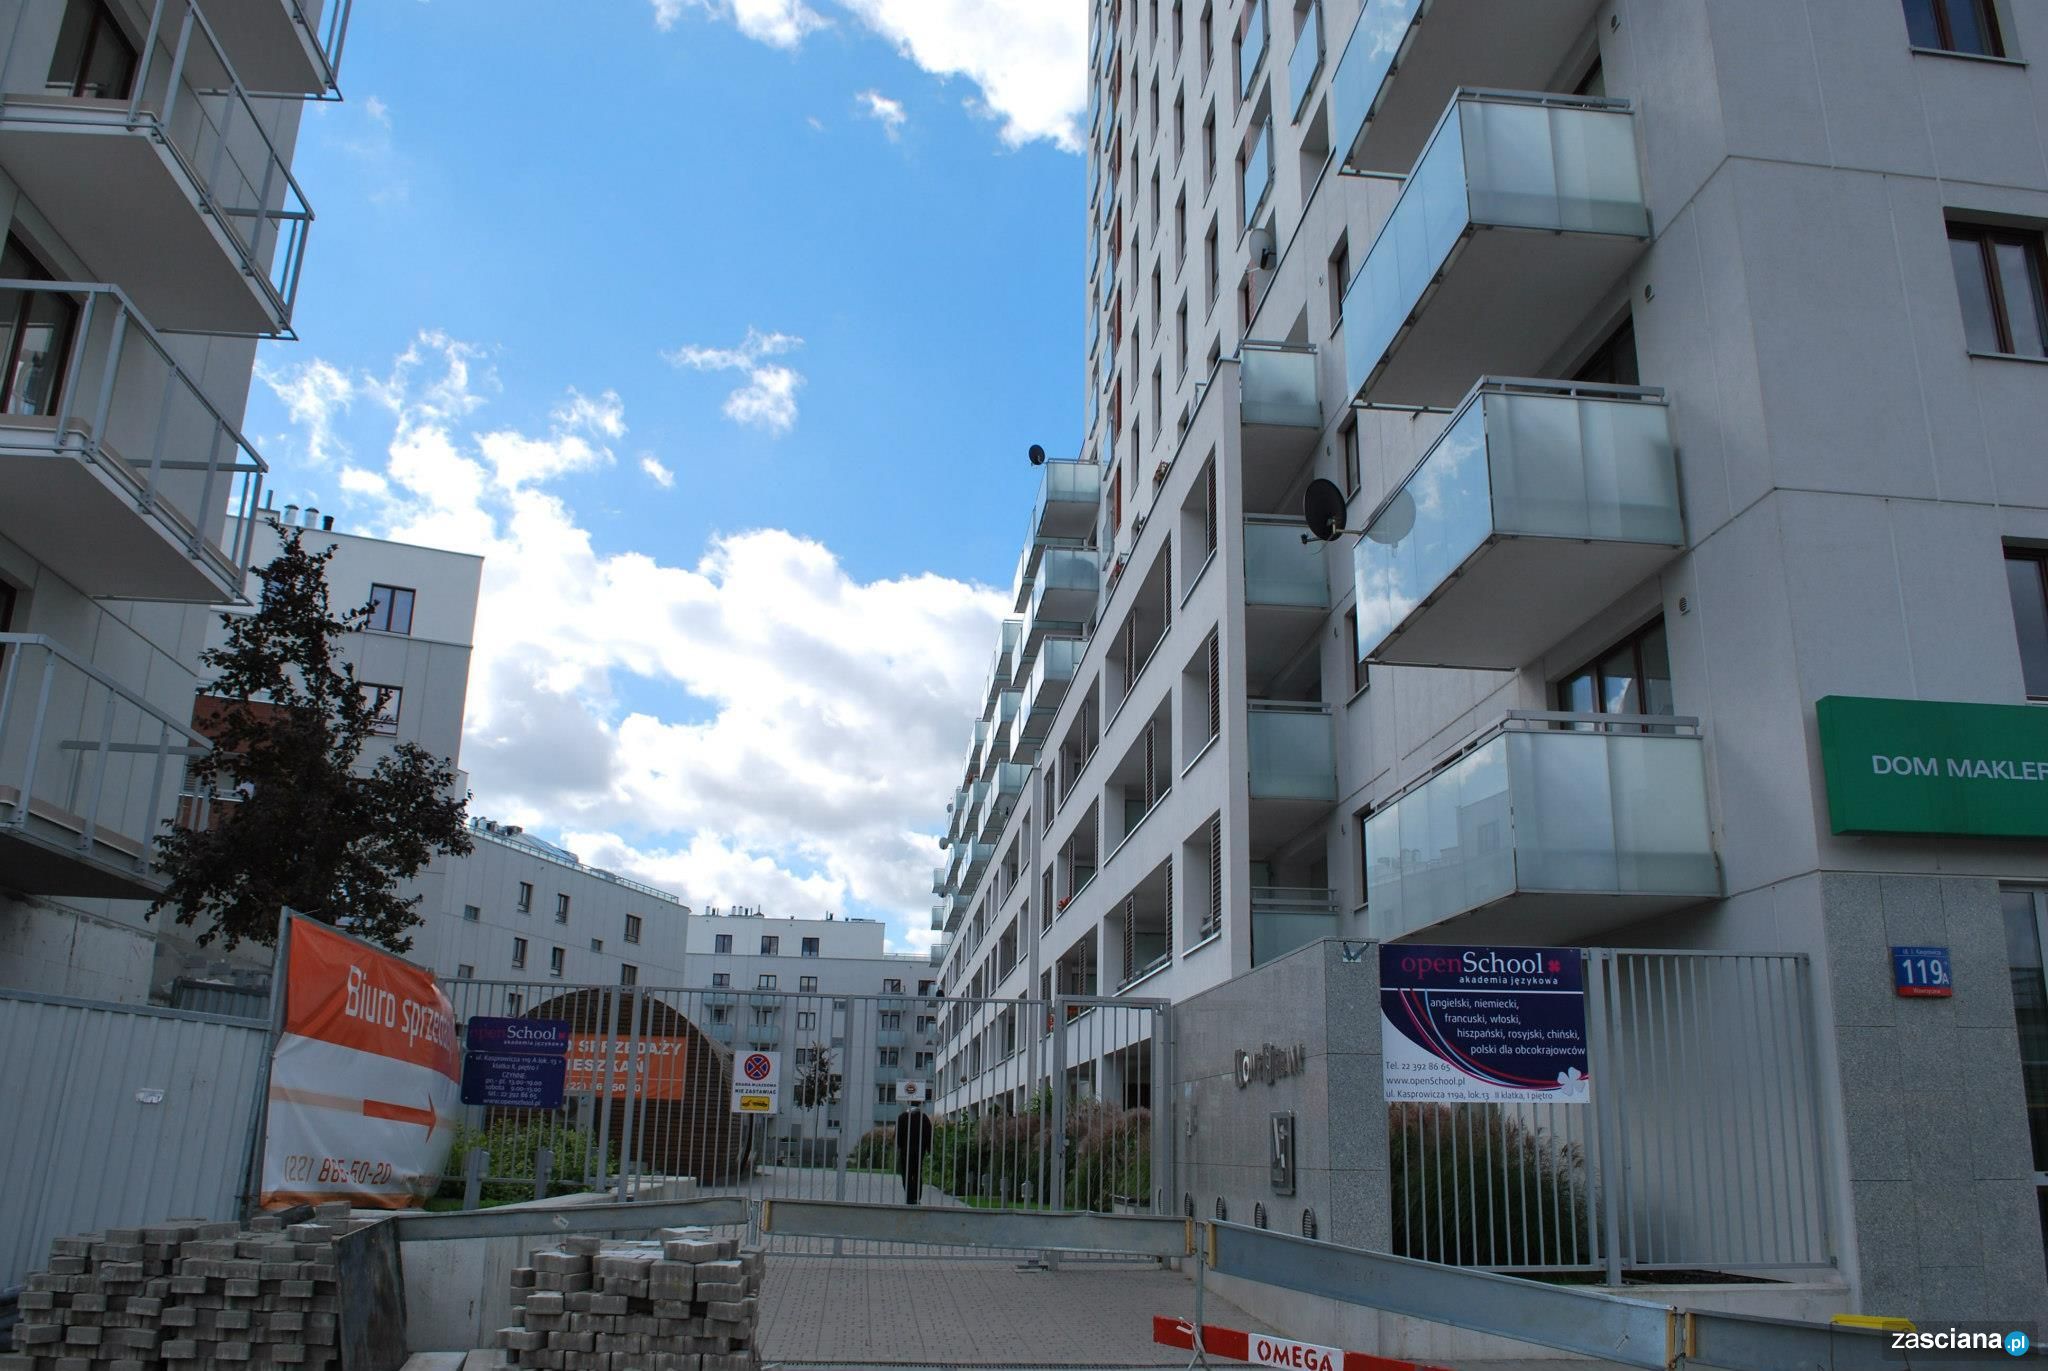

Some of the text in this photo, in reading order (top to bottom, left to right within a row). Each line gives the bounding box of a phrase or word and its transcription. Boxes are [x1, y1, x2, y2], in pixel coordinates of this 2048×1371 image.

[1872, 755, 1939, 776] DOM
[1401, 951, 1544, 980] openSchool
[1459, 976, 1559, 987] akademia językowa
[346, 964, 396, 1029] Biuro
[1430, 999, 1520, 1010] angielski, niemiecki,
[1445, 1014, 1521, 1025] francuski, włoski,
[1457, 1029, 1580, 1041] hiszpański, rosyjski, chiński,
[1470, 1045, 1586, 1056] polski dla obcokrajowców
[567, 1057, 645, 1073] IESZKAŃ
[1386, 1062, 1400, 1070] Tel.
[1412, 1064, 1427, 1072] 392
[1428, 1062, 1439, 1070] 86
[1440, 1063, 1451, 1072] 65
[1386, 1077, 1466, 1087] www.openSchool.pl
[1386, 1091, 1395, 1099] ul.
[1397, 1091, 1445, 1101] Kasprowicza
[1501, 1092, 1526, 1101] klatka,
[1531, 1092, 1553, 1102] piętro
[285, 1155, 314, 1185] (22)
[318, 1158, 392, 1185] 865-50-20
[1257, 1339, 1333, 1371] OMEGA
